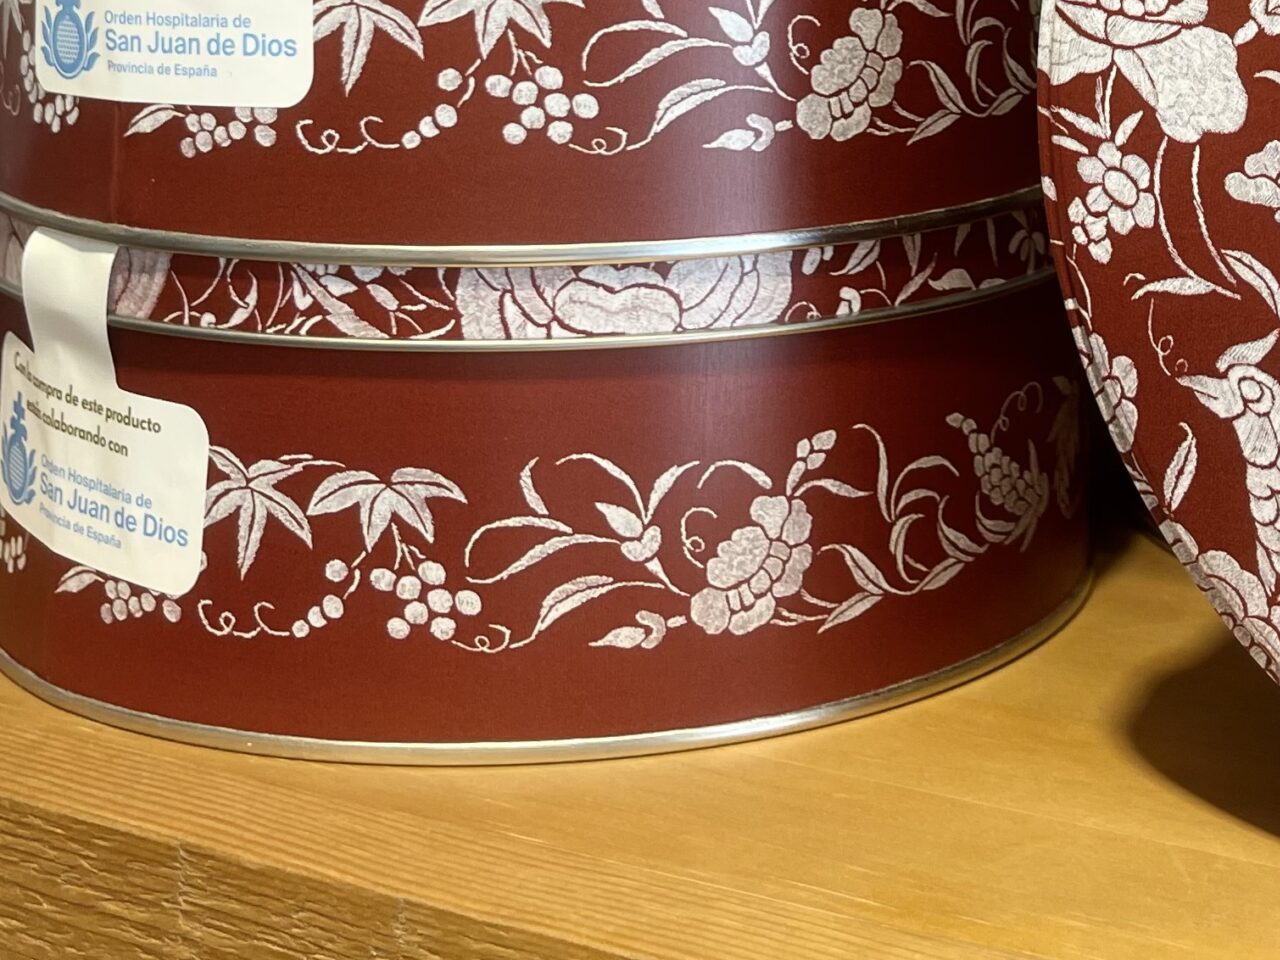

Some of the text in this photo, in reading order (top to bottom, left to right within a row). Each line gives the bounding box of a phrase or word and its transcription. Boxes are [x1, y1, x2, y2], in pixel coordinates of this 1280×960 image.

[104, 10, 252, 29] Orden Hospitalaria de
[105, 29, 297, 57] San Juan de Dios
[107, 60, 218, 79] Provincia de España
[65, 384, 79, 406] de
[81, 398, 104, 415] este
[105, 406, 162, 434] producto
[42, 407, 106, 448] colaborando
[108, 440, 128, 457] con
[41, 454, 152, 509] Orden Hospitalaria de
[40, 472, 189, 547] San Juan de Dios
[73, 521, 85, 535] de
[87, 526, 122, 549] España
